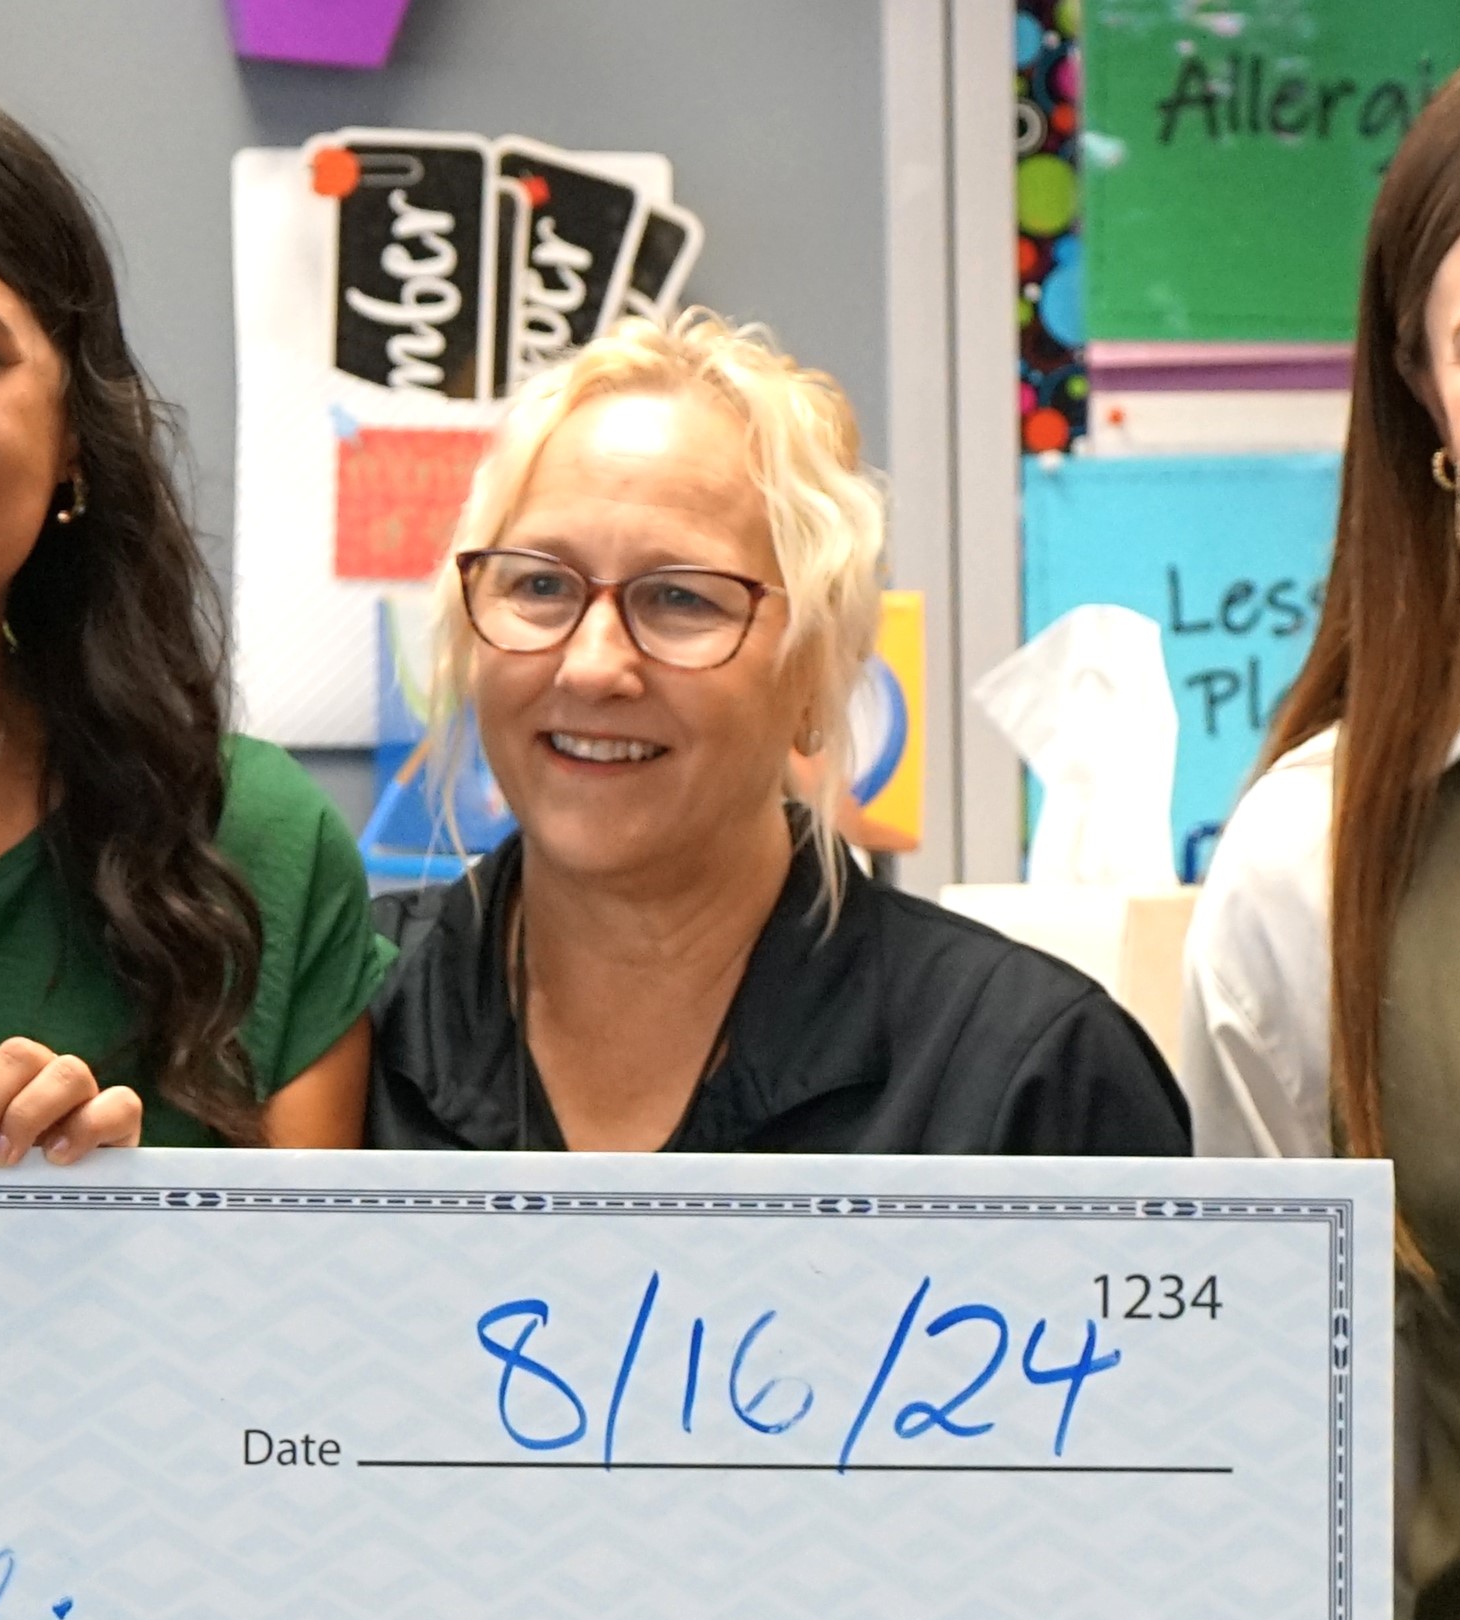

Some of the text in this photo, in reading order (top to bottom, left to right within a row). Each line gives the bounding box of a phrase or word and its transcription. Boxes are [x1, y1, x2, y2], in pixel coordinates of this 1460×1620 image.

[1091, 1272, 1224, 1323] 1234
[479, 1270, 1122, 1475] 8/16/24
[241, 1427, 344, 1471] Date
